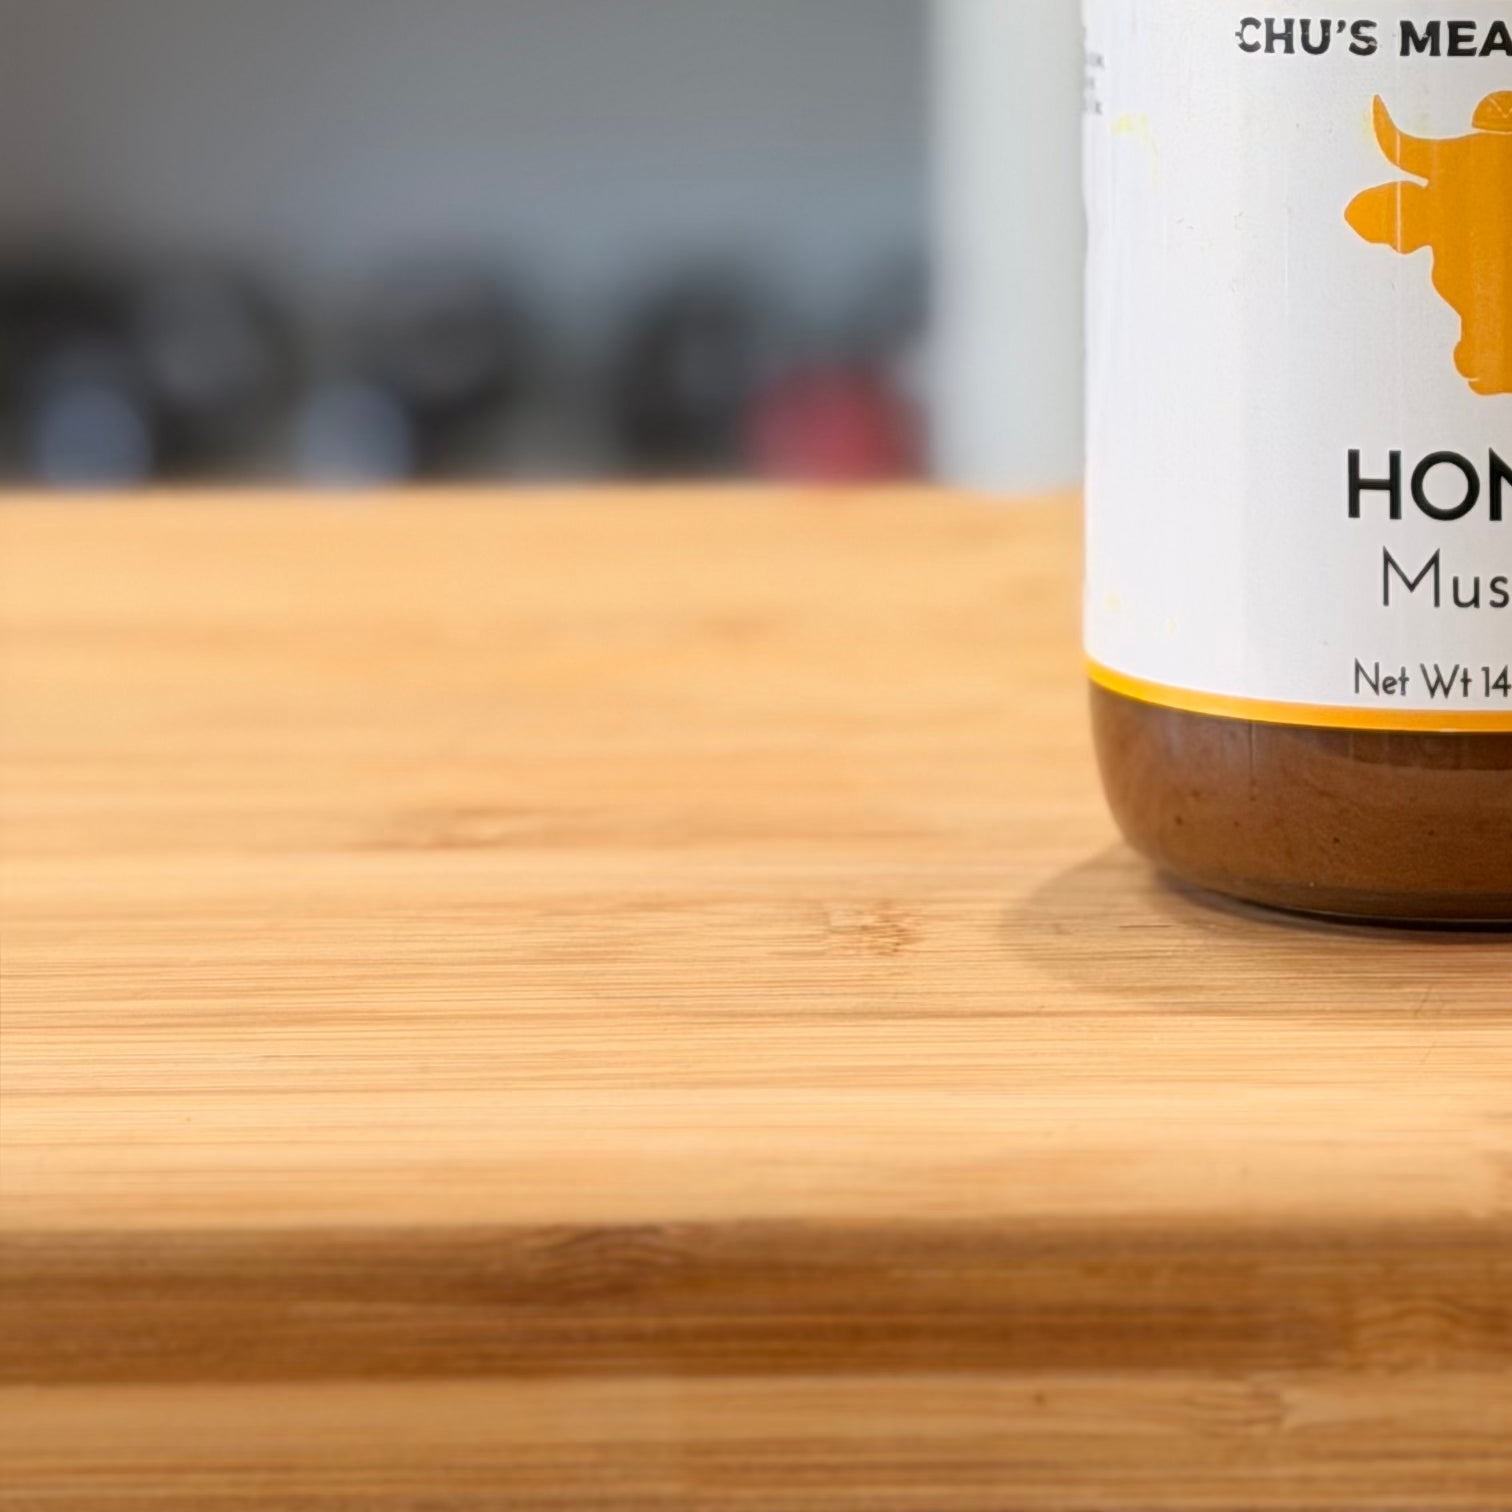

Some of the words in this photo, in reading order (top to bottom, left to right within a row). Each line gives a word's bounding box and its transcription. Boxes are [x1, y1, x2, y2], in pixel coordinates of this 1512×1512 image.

[1236, 16, 1378, 57] CHU'S
[1354, 657, 1410, 696] Net
[1420, 663, 1473, 699] Wt
[1481, 664, 1512, 698] 14
